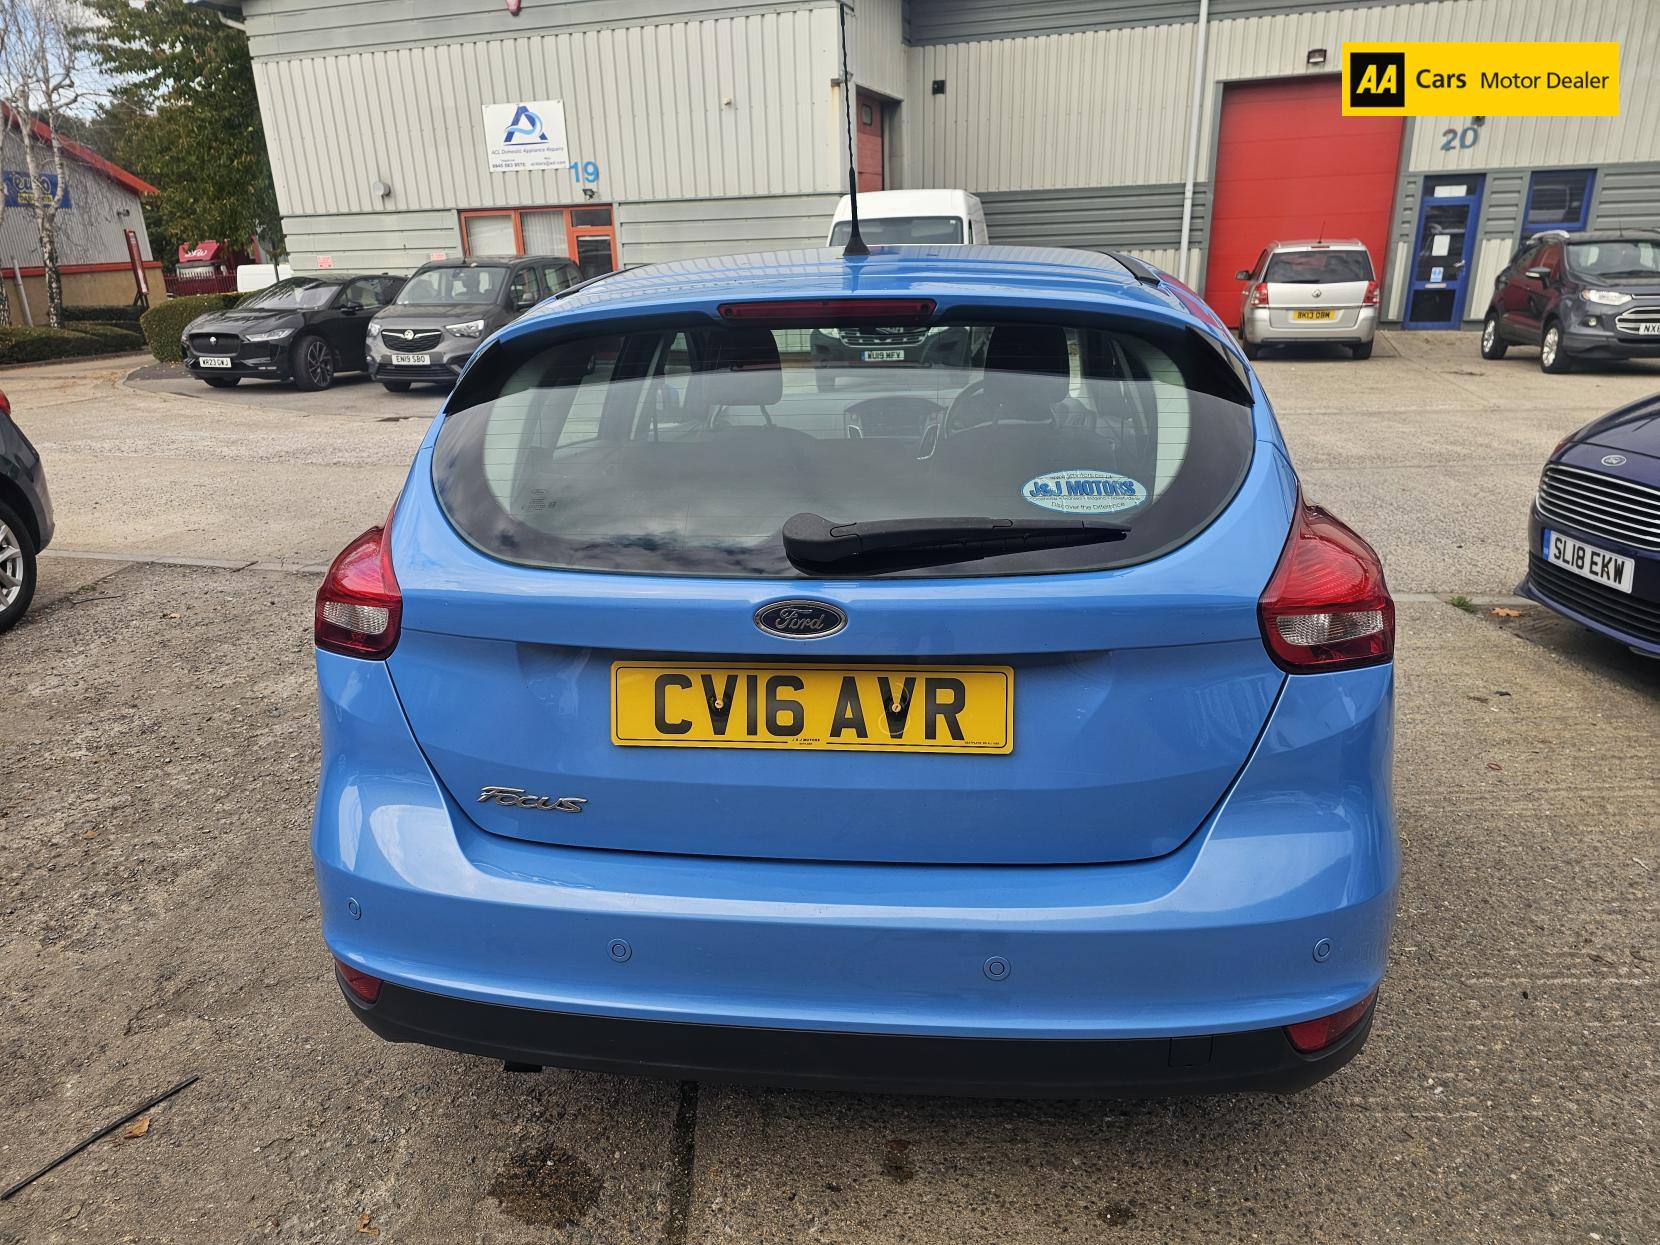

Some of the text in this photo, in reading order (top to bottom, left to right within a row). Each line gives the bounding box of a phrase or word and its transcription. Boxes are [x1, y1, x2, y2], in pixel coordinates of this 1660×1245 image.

[1440, 126, 1479, 151] 20
[570, 161, 599, 183] 19
[201, 358, 216, 366] WR23
[395, 355, 426, 363] EN19 SBO
[1029, 479, 1136, 497] J&J MOTORS
[1553, 536, 1625, 585] SL18 EKW
[775, 607, 826, 629] Ford
[653, 673, 967, 741] CV16 AVR
